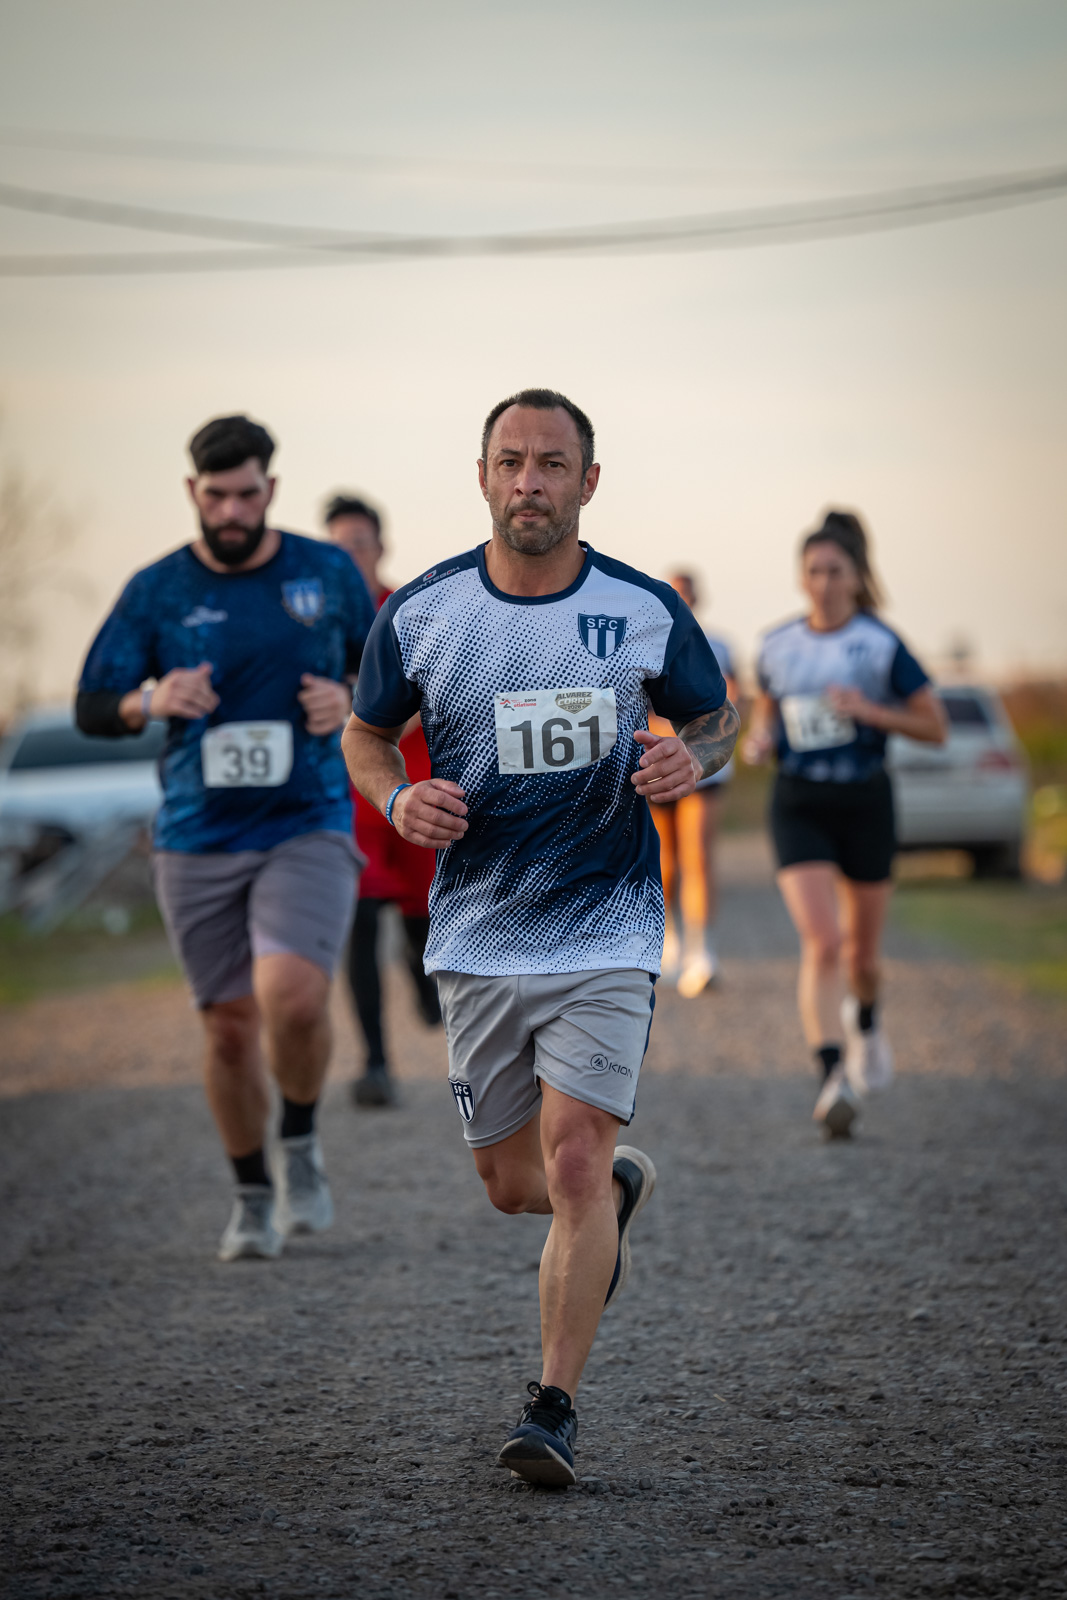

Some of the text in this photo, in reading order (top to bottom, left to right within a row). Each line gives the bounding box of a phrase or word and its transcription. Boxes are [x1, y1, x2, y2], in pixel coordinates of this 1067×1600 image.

[586, 618, 618, 630] SFC
[557, 697, 591, 705] CORRE
[510, 716, 600, 769] 161
[221, 744, 271, 784] 39
[453, 1085, 469, 1095] SFC
